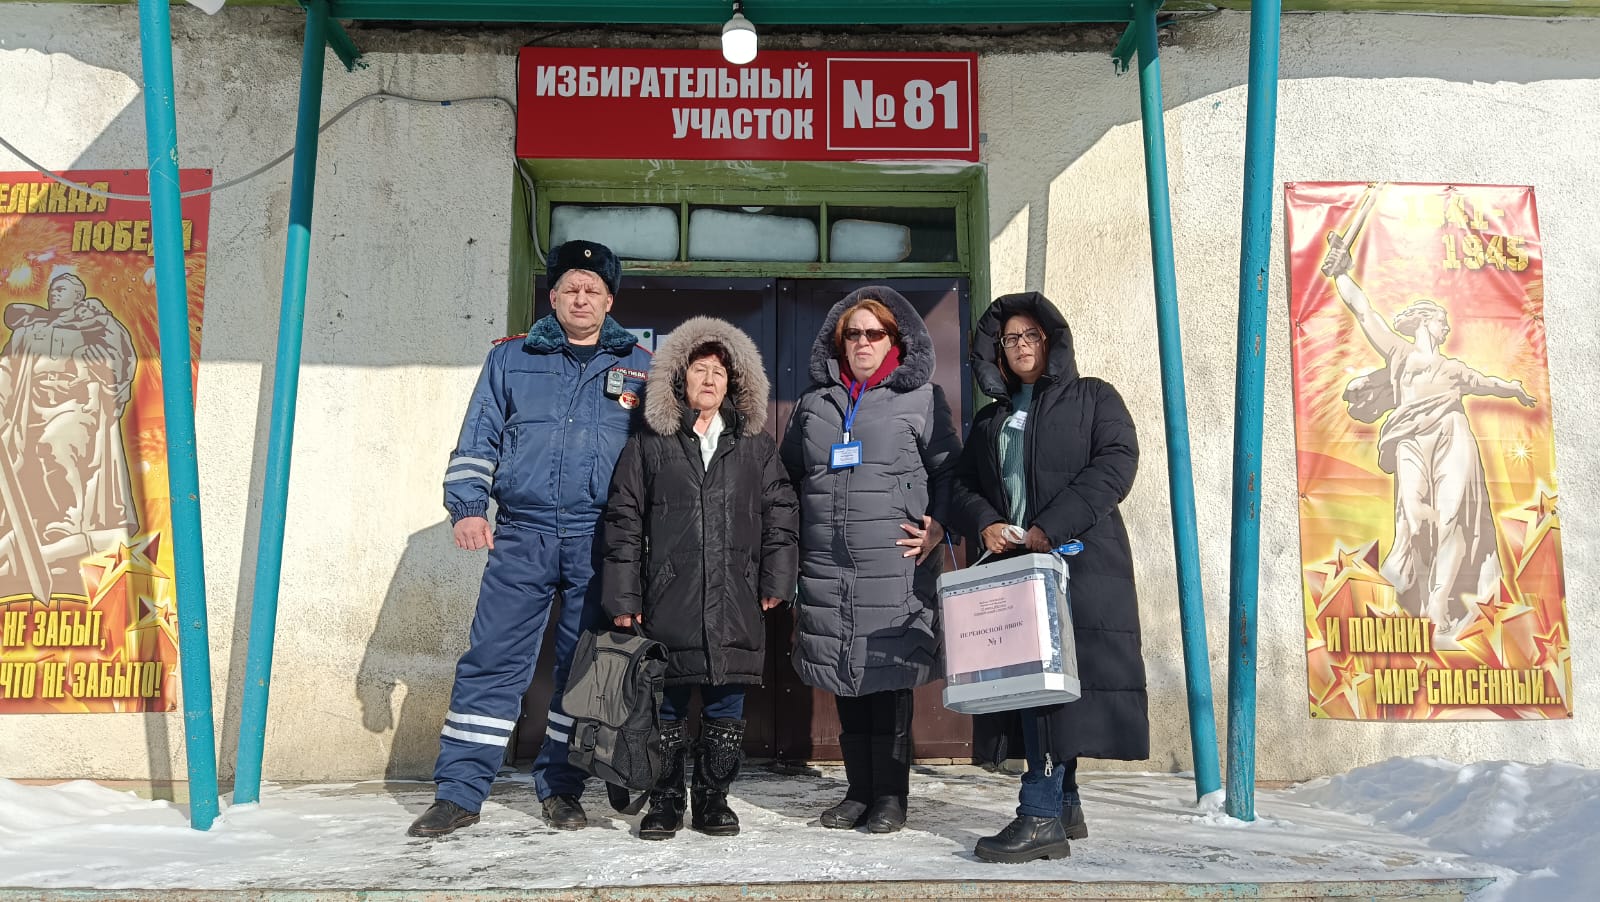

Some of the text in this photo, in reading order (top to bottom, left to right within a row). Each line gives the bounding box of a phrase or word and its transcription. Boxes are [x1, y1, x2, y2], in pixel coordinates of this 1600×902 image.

[536, 62, 814, 99] ИЗБИРАТЕЛЬНЫЙ
[843, 79, 958, 130] № 81
[672, 108, 814, 140] УЧАСТОК
[1403, 195, 1505, 230] 141-
[72, 221, 193, 256] ПОБЕ
[1442, 234, 1529, 272] 1945
[3, 610, 106, 650] НЕ ЗАБЫТ,
[1325, 617, 1431, 653] И ПОМНИТ
[42, 661, 66, 699] НЕ
[72, 661, 163, 699] ЗАБЫТО!
[1374, 668, 1419, 705] МИР
